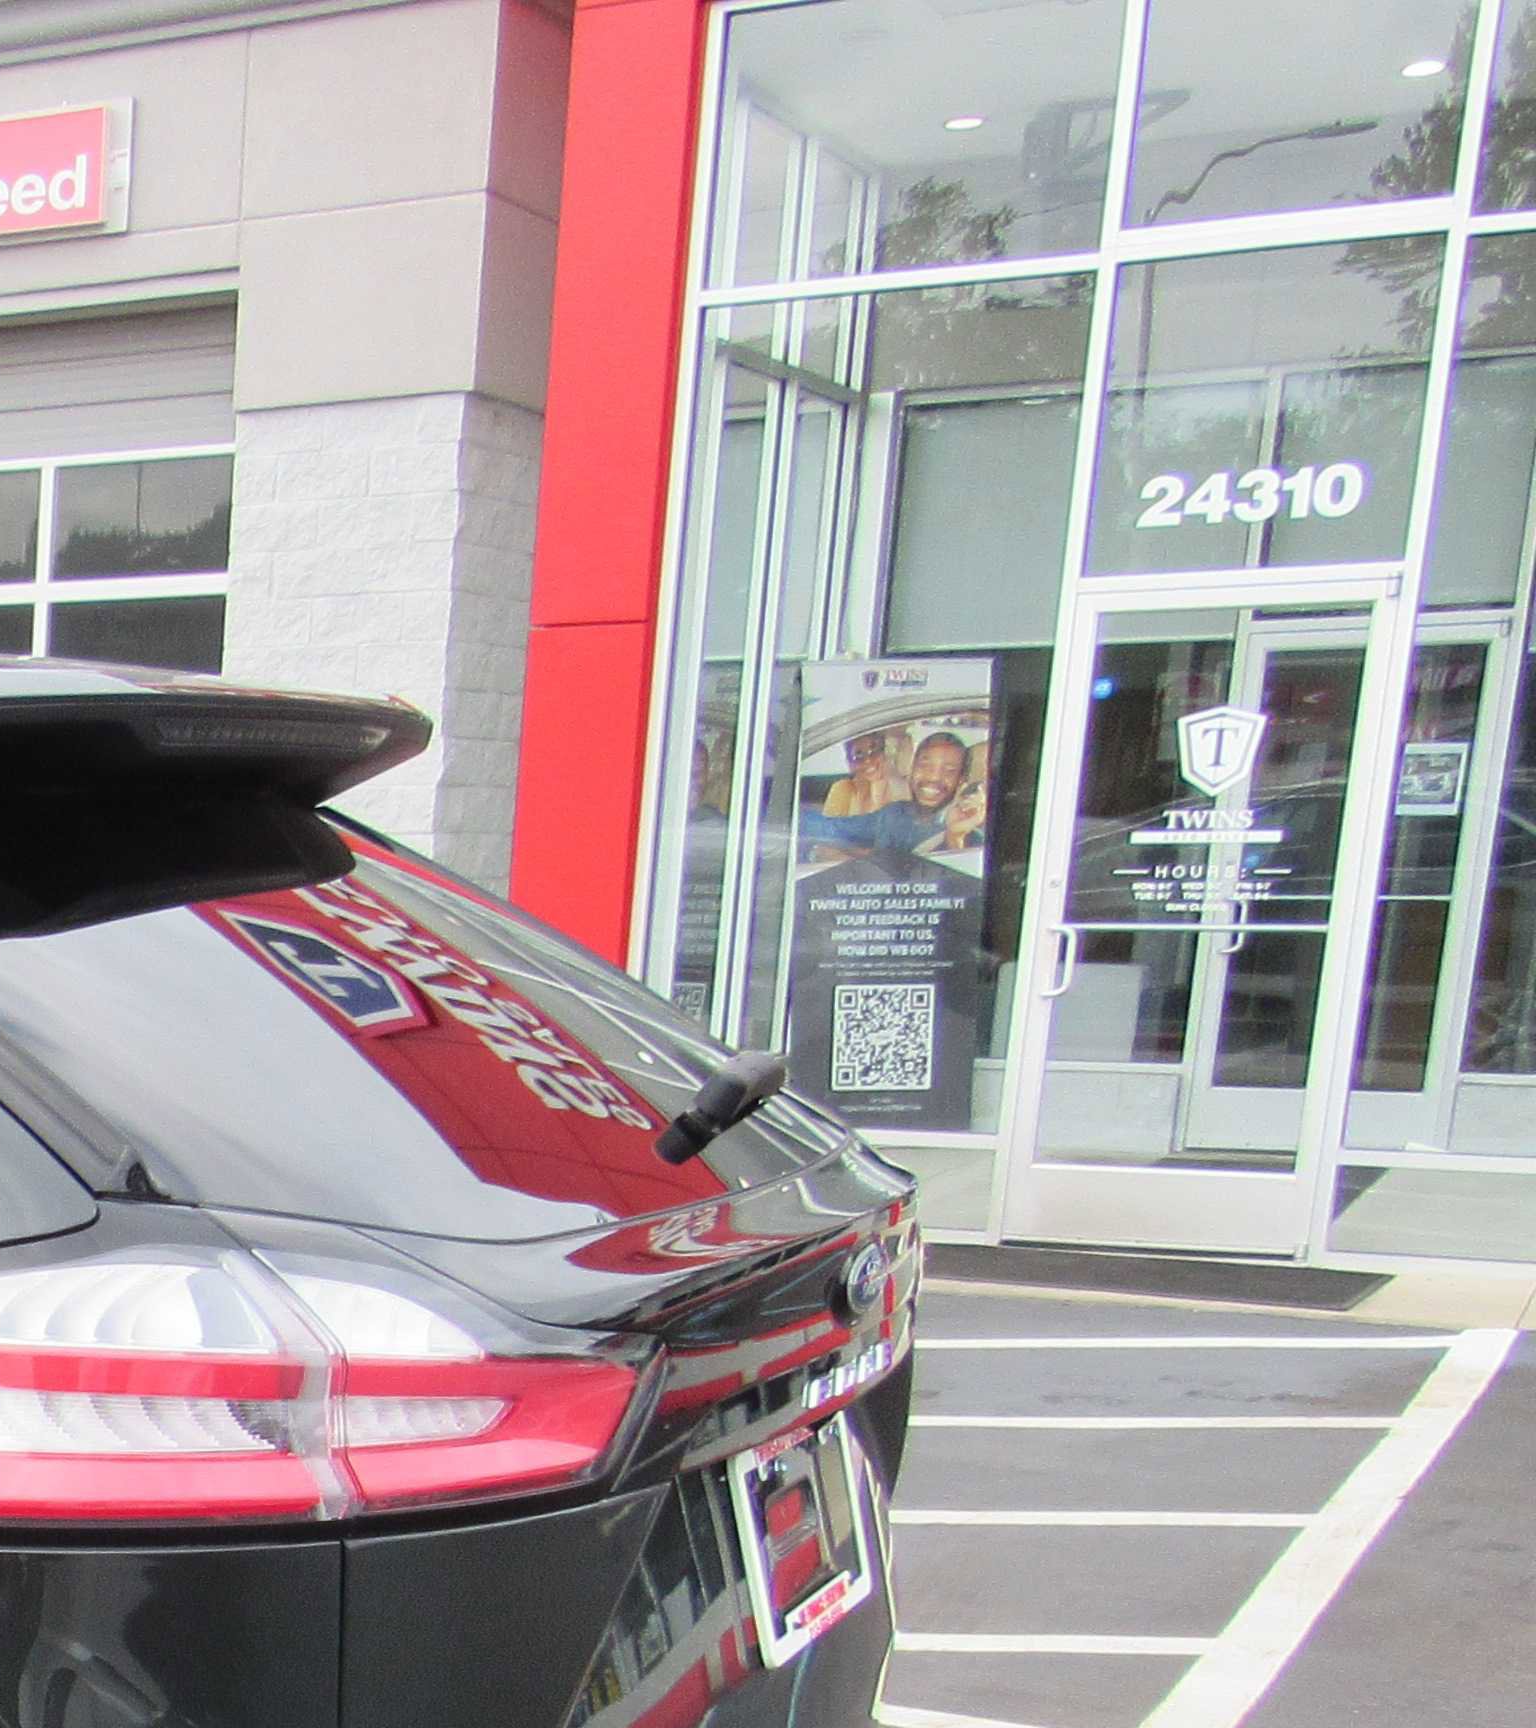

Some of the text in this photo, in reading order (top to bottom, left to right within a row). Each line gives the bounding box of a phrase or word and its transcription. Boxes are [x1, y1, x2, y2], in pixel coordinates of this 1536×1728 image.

[1135, 462, 1364, 529] 24310
[1201, 727, 1240, 768] T
[1162, 809, 1255, 829] TWINS
[835, 883, 938, 895] WELCOME TO OUR
[809, 898, 966, 911] TWINS AUTO SALES FAMILY!
[835, 914, 866, 926] YOUR
[868, 914, 925, 925] FEEDBACK
[831, 929, 897, 941] IMPORTANT
[899, 929, 914, 940] TO
[837, 945, 867, 956] HOW
[890, 944, 908, 955] WE
